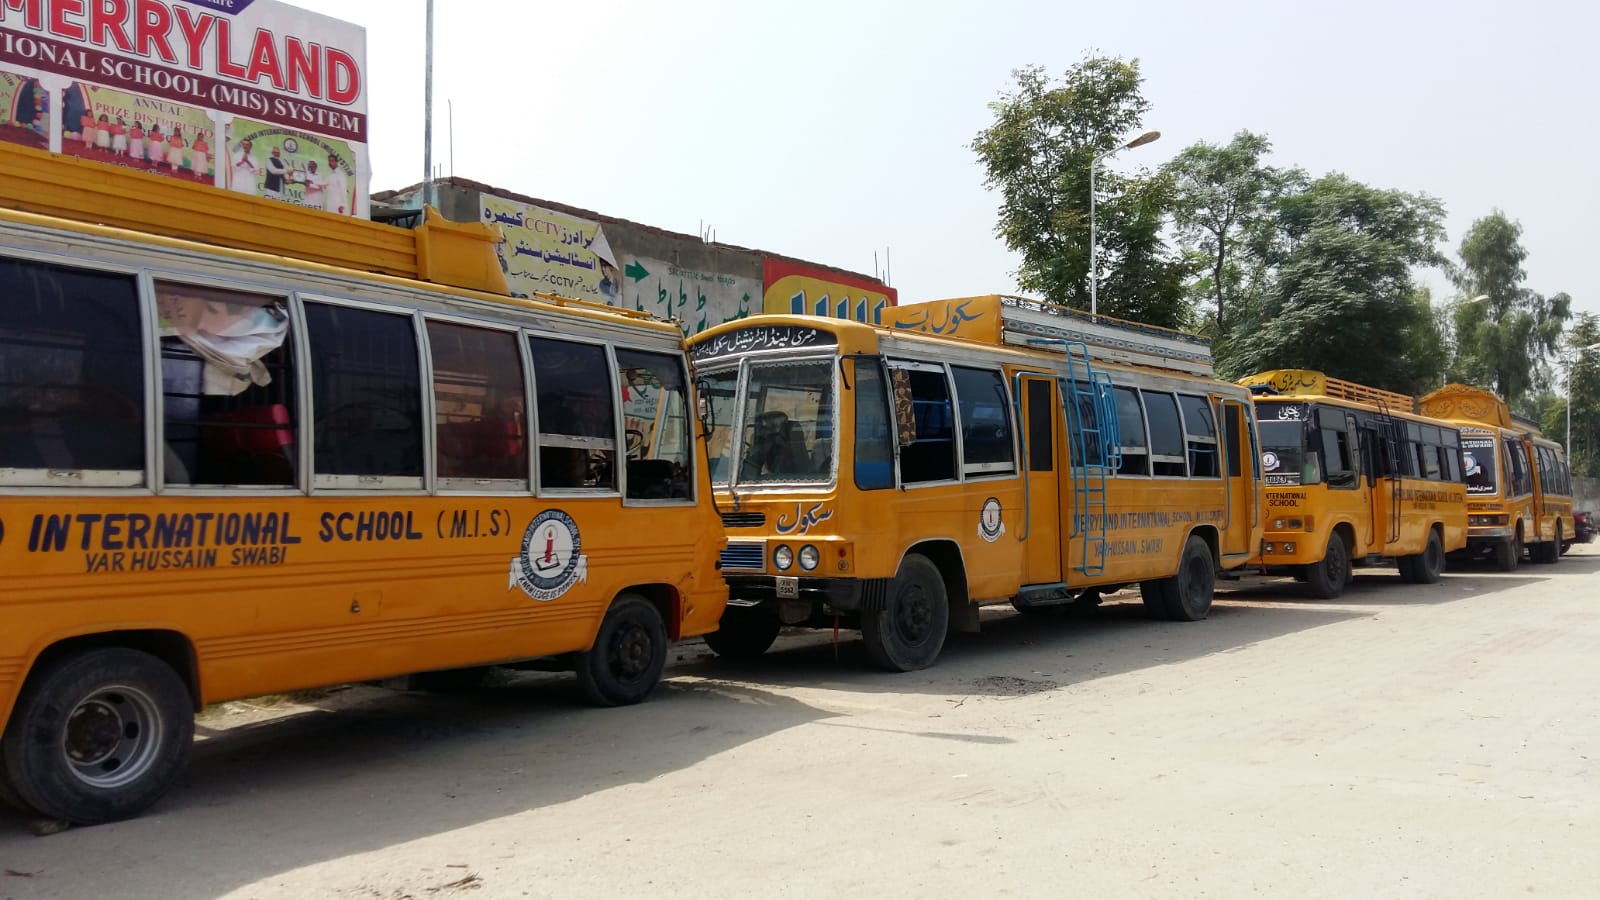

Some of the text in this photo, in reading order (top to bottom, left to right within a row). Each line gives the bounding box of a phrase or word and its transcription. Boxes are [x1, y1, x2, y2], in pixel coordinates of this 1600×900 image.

[0, 32, 360, 134] IONAL SCHOOL (MIS) SYSTEM
[95, 102, 129, 119] PRIZE
[524, 217, 558, 236] CCTV
[550, 275, 574, 288] CCTV
[931, 300, 984, 334] سکول
[1266, 492, 1306, 500] NTERNATIONAL
[28, 511, 301, 552] INTERNATIONAL
[319, 511, 422, 542] SCHOOL
[776, 501, 833, 536] سکول
[85, 546, 287, 573] YAR HUSSAIN SWABI
